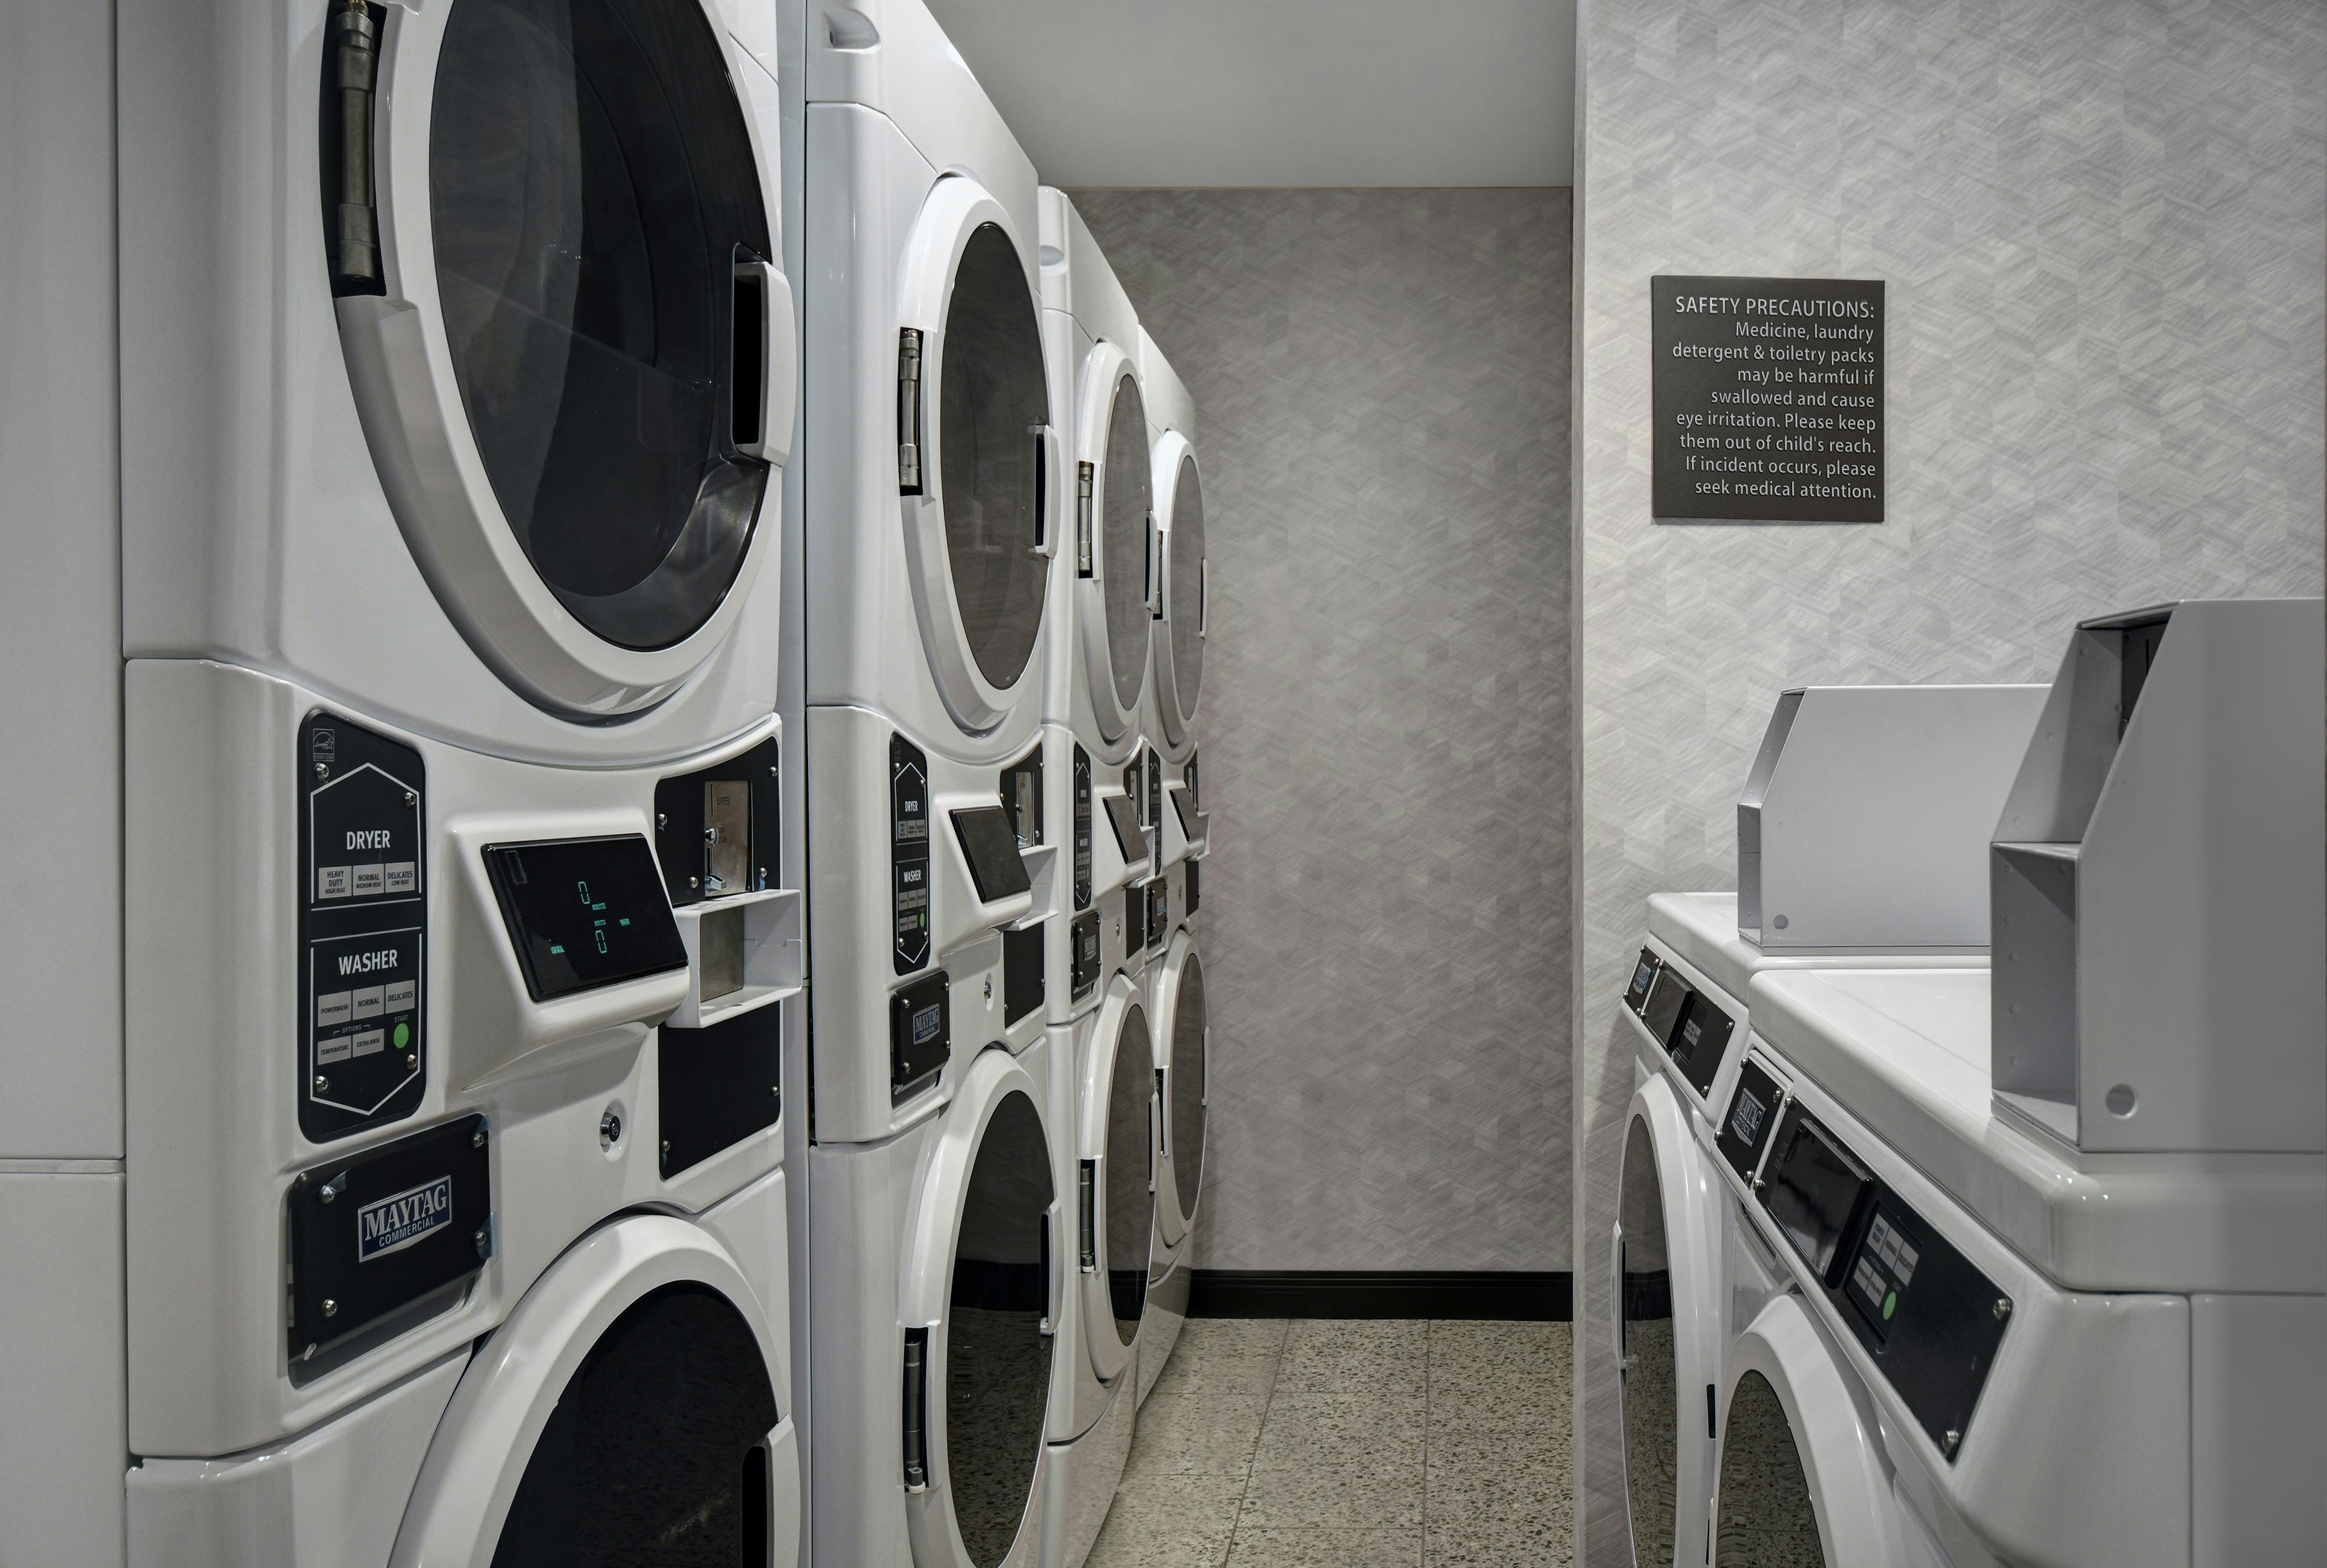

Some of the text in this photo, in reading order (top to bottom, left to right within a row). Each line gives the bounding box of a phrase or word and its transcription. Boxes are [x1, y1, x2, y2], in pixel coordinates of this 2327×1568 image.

[1675, 295, 1874, 318] SAFETY PRECAUTIONS:
[1736, 321, 1874, 344] Medicine, laundry
[1672, 341, 1874, 366] detergent & toiletry packs
[1738, 367, 1875, 386] may be harmful if
[1711, 388, 1874, 408] swallowed and cause
[1676, 410, 1876, 434] eye irritation. Please keep
[1679, 432, 1876, 453] them out of child's reach.
[1686, 455, 1876, 478] If incident occurs, please
[1695, 478, 1876, 499] seek medical attention.
[905, 800, 918, 812] DRYER
[347, 830, 391, 850] DRYER
[327, 870, 344, 878] HEAVY
[358, 873, 380, 881] NORMAL
[387, 870, 413, 879] DELICATES
[903, 869, 922, 883] WASHER
[338, 949, 398, 976] WASHER
[358, 997, 380, 1008] NORMAL
[388, 991, 413, 1002] DELICATES
[321, 1004, 349, 1014] POWERWASH
[394, 1014, 409, 1023] START
[342, 1024, 362, 1033] OPTIONS
[915, 1008, 938, 1033] MAYTAG
[321, 1044, 349, 1055] TEMPERATURE
[364, 1184, 447, 1241] MAYTAG
[379, 1216, 435, 1247] COMMERCIAL
